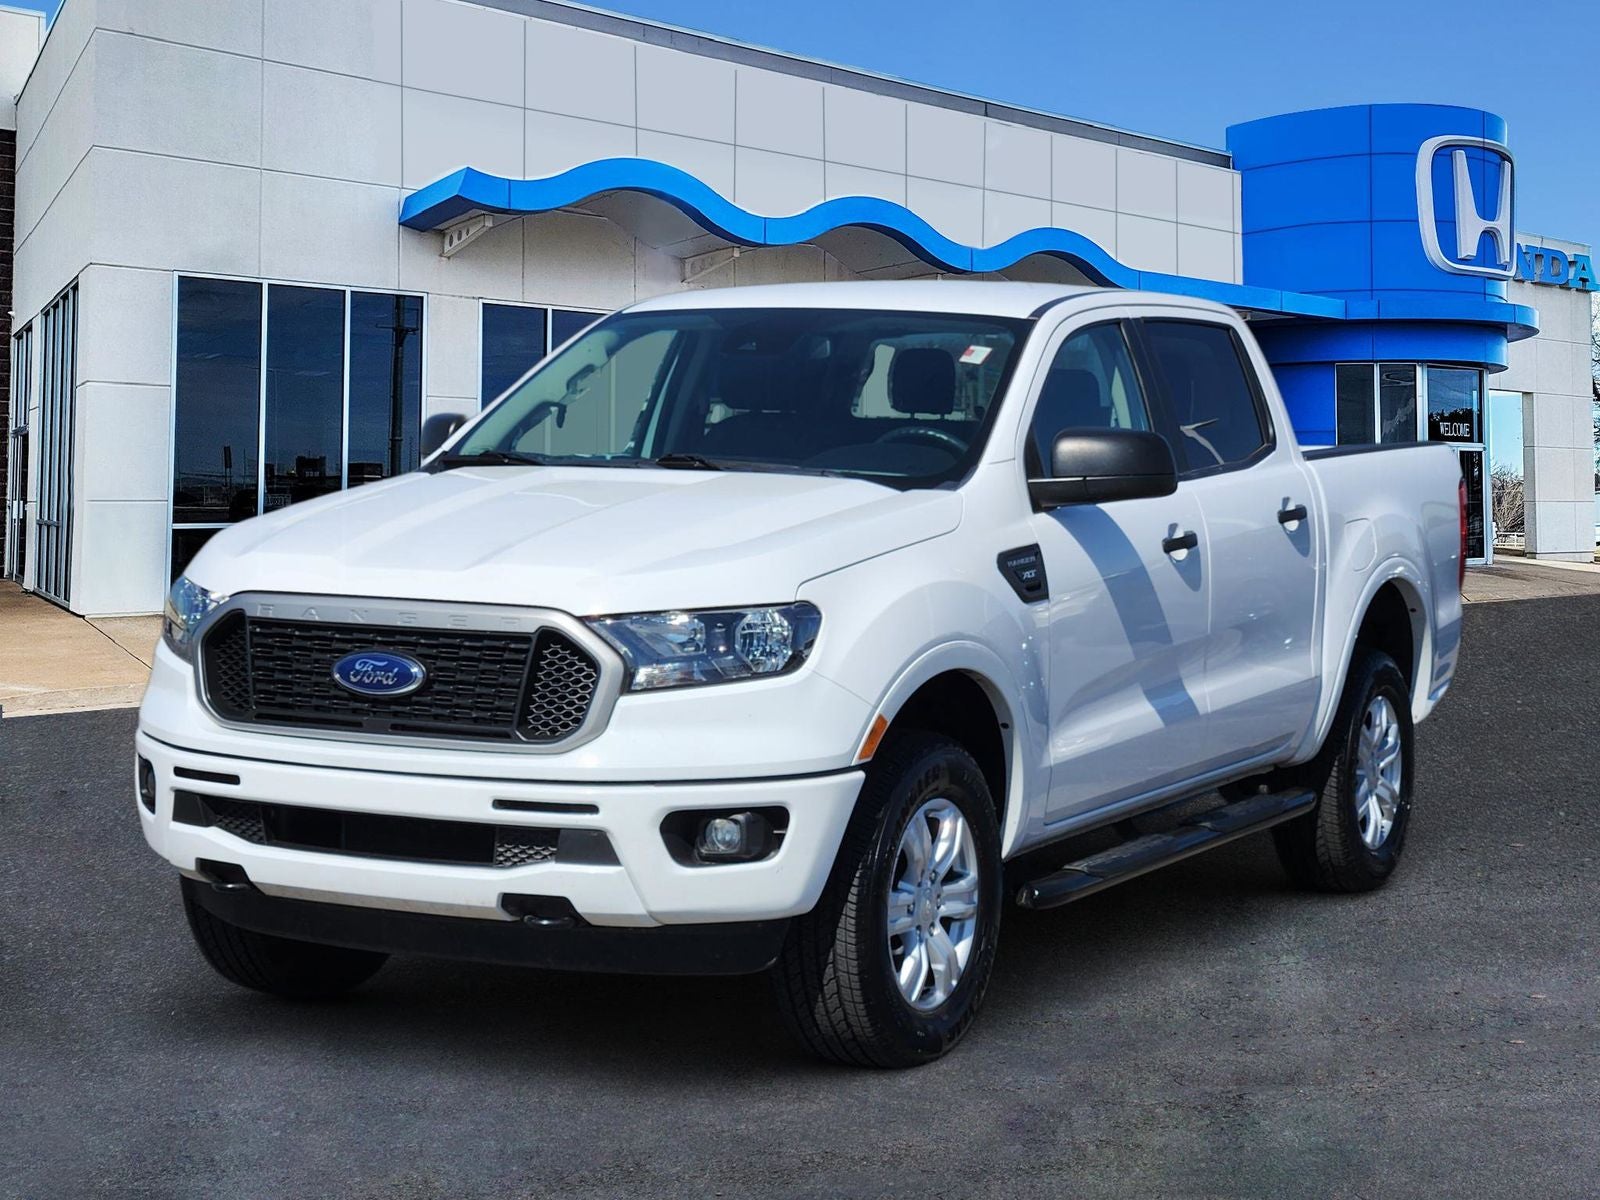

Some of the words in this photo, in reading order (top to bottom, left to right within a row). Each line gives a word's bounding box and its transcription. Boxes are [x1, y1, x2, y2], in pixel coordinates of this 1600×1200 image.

[1513, 243, 1600, 293] NDA
[1439, 421, 1471, 437] WELCOME
[256, 603, 521, 628] RANGER
[349, 658, 398, 686] Ford
